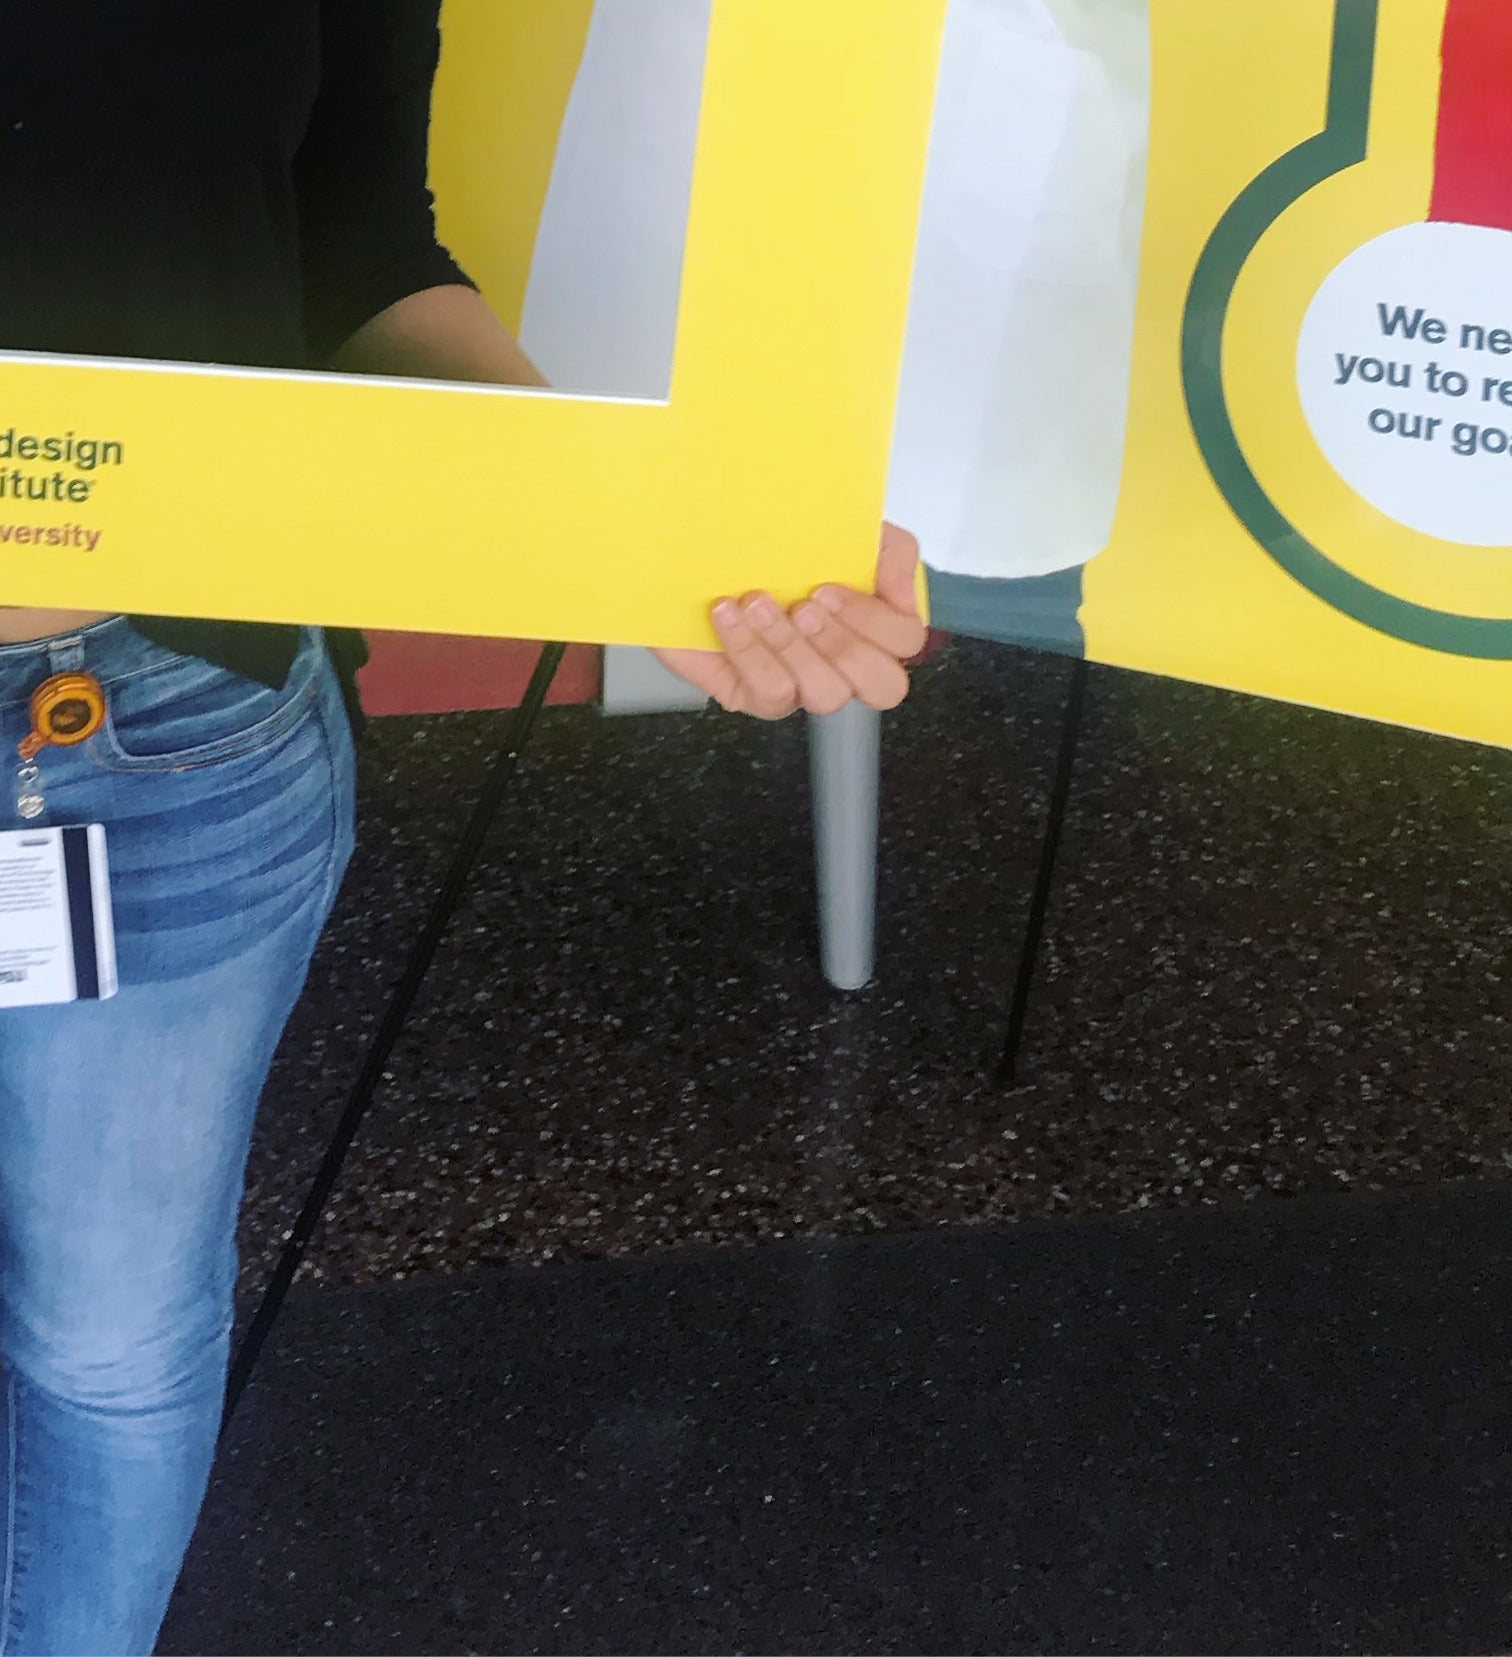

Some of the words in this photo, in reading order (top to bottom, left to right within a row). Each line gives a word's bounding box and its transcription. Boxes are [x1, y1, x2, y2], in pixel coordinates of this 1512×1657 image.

[1377, 302, 1447, 344] We
[1459, 323, 1512, 355] ne
[1333, 352, 1412, 388] you
[1424, 361, 1468, 397] to
[1367, 407, 1442, 441] our
[1450, 422, 1512, 456] go
